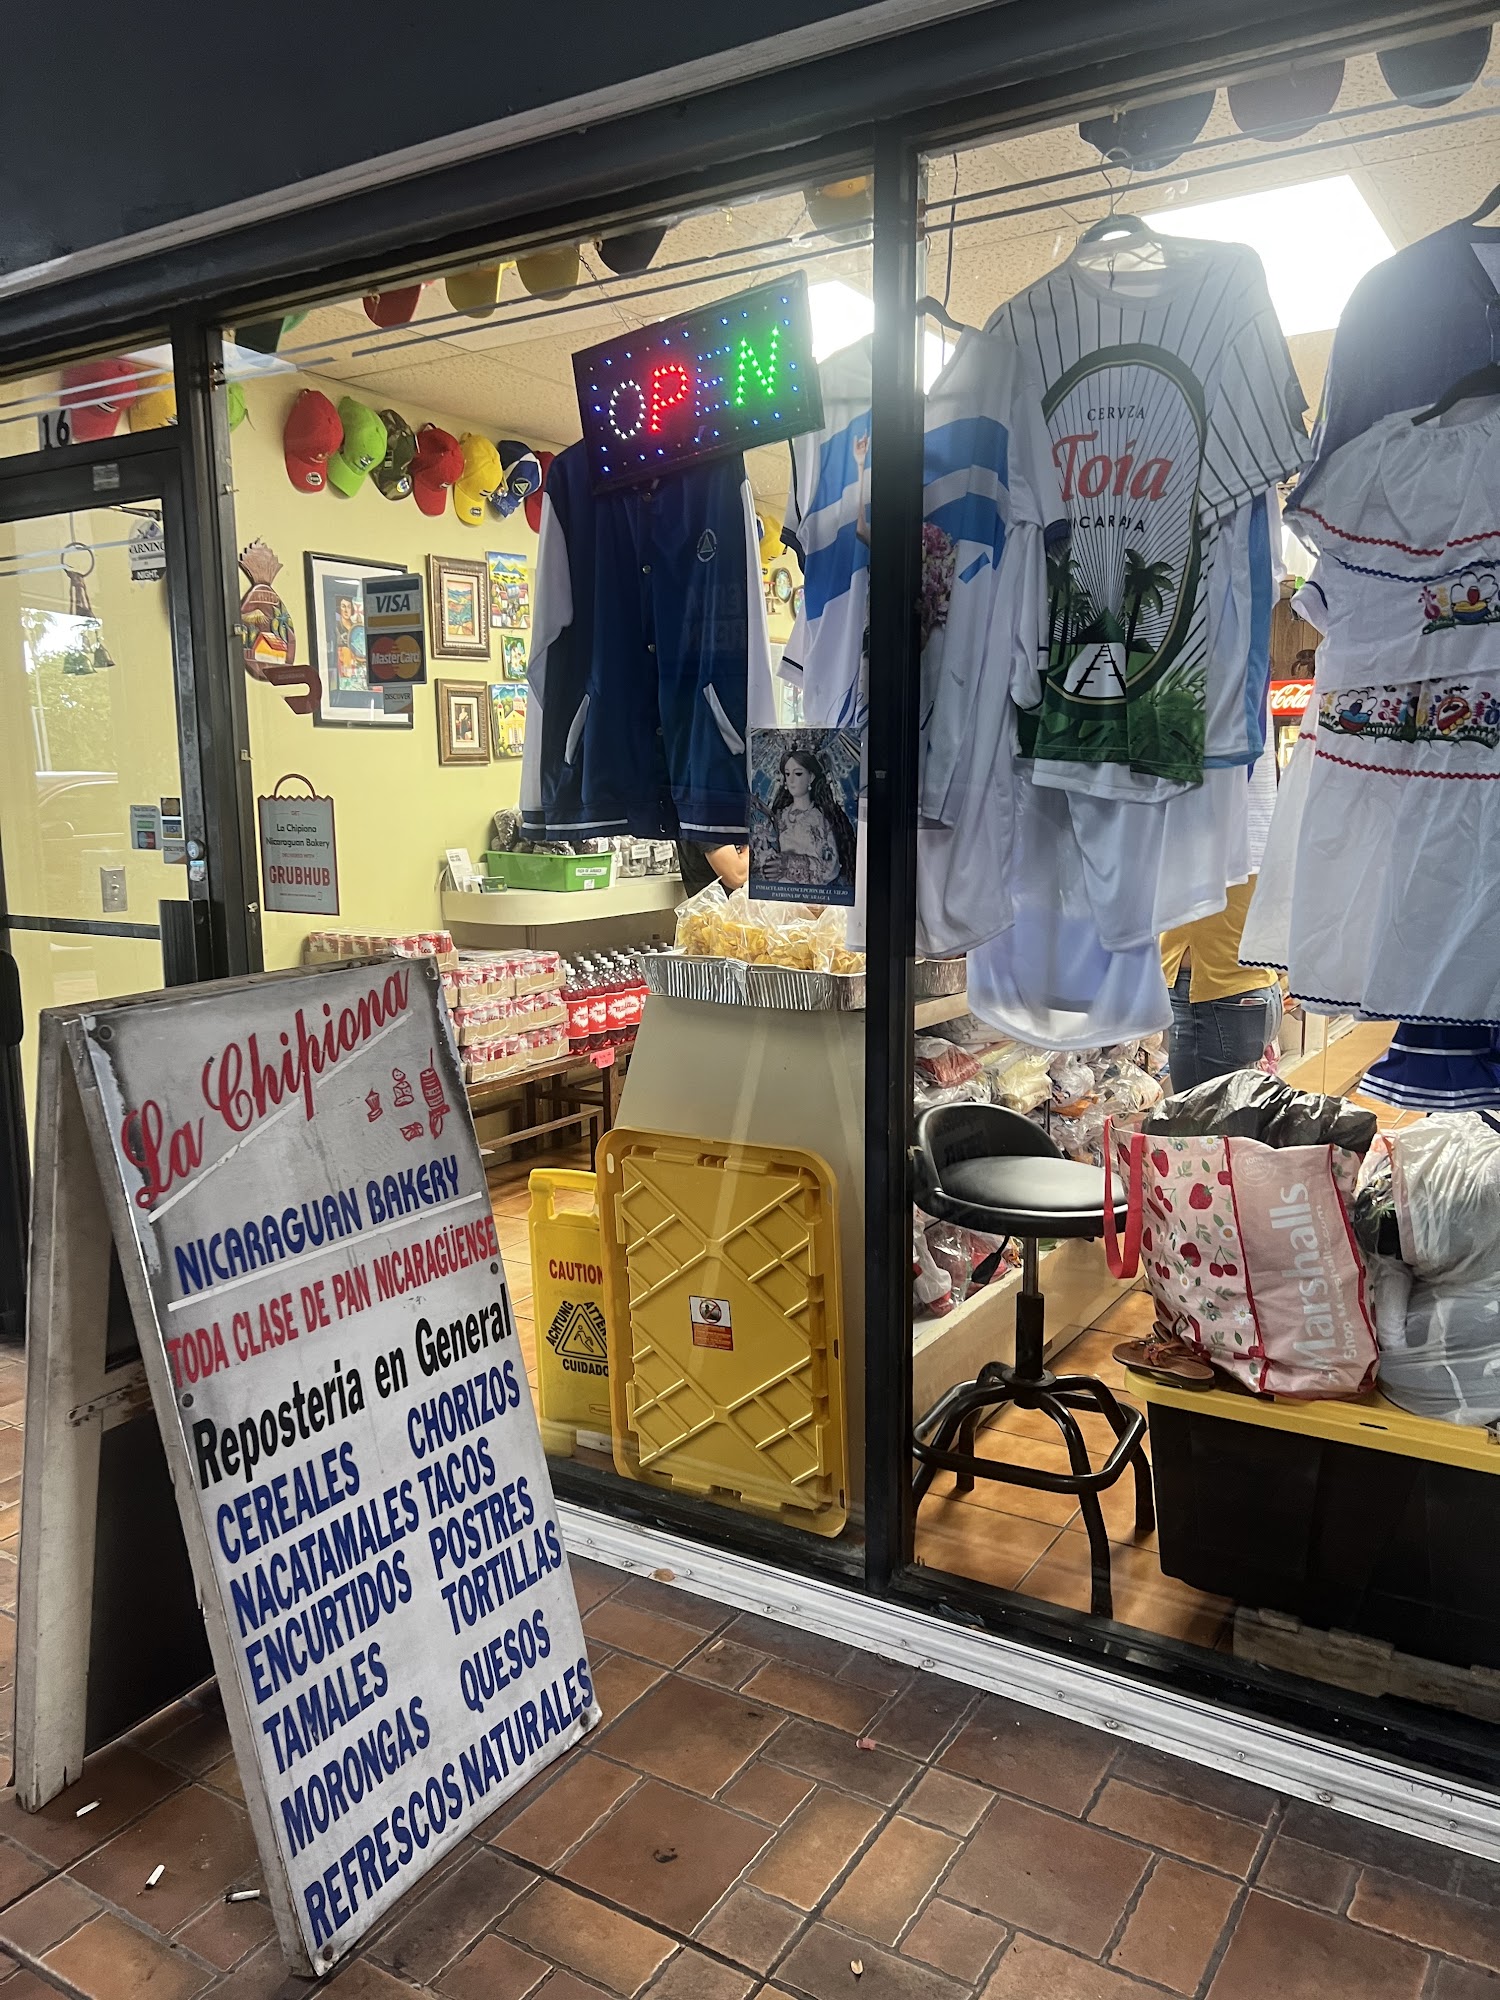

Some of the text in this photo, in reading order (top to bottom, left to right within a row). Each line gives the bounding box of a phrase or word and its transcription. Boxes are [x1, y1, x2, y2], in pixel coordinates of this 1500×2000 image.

[42, 410, 70, 448] 16
[609, 325, 779, 440] OPEN
[371, 651, 420, 665] MasterCard
[375, 593, 411, 613] VISA
[384, 692, 411, 700] DISCOVER
[265, 837, 330, 849] Nicaraguan Bakery
[269, 865, 331, 887] GRUBHUB
[276, 823, 317, 834] La Chipiona
[121, 968, 410, 1209] La Chipiona
[174, 1154, 460, 1295] NICARAGUAN BAKERY
[1268, 1182, 1337, 1379] Marshalls
[1315, 1204, 1358, 1360] Shop Marshalls.com
[167, 1215, 498, 1389] TODA CLASE DE PAN NICARAGÜENSE
[374, 1346, 409, 1399] en
[415, 1282, 512, 1378] General
[545, 1300, 574, 1346] ACHTUNG
[216, 1359, 521, 1565] CEREALES CHORIZOS
[229, 1435, 497, 1639] NACATAMALES TACOS
[244, 1475, 536, 1706] ENCURTIDOS POSTRES
[262, 1519, 563, 1776] TAMALES TORTILLAS
[280, 1608, 552, 1859] MORONGAS QUESOS
[303, 1657, 594, 1950] REFRESCOS NATURALES
